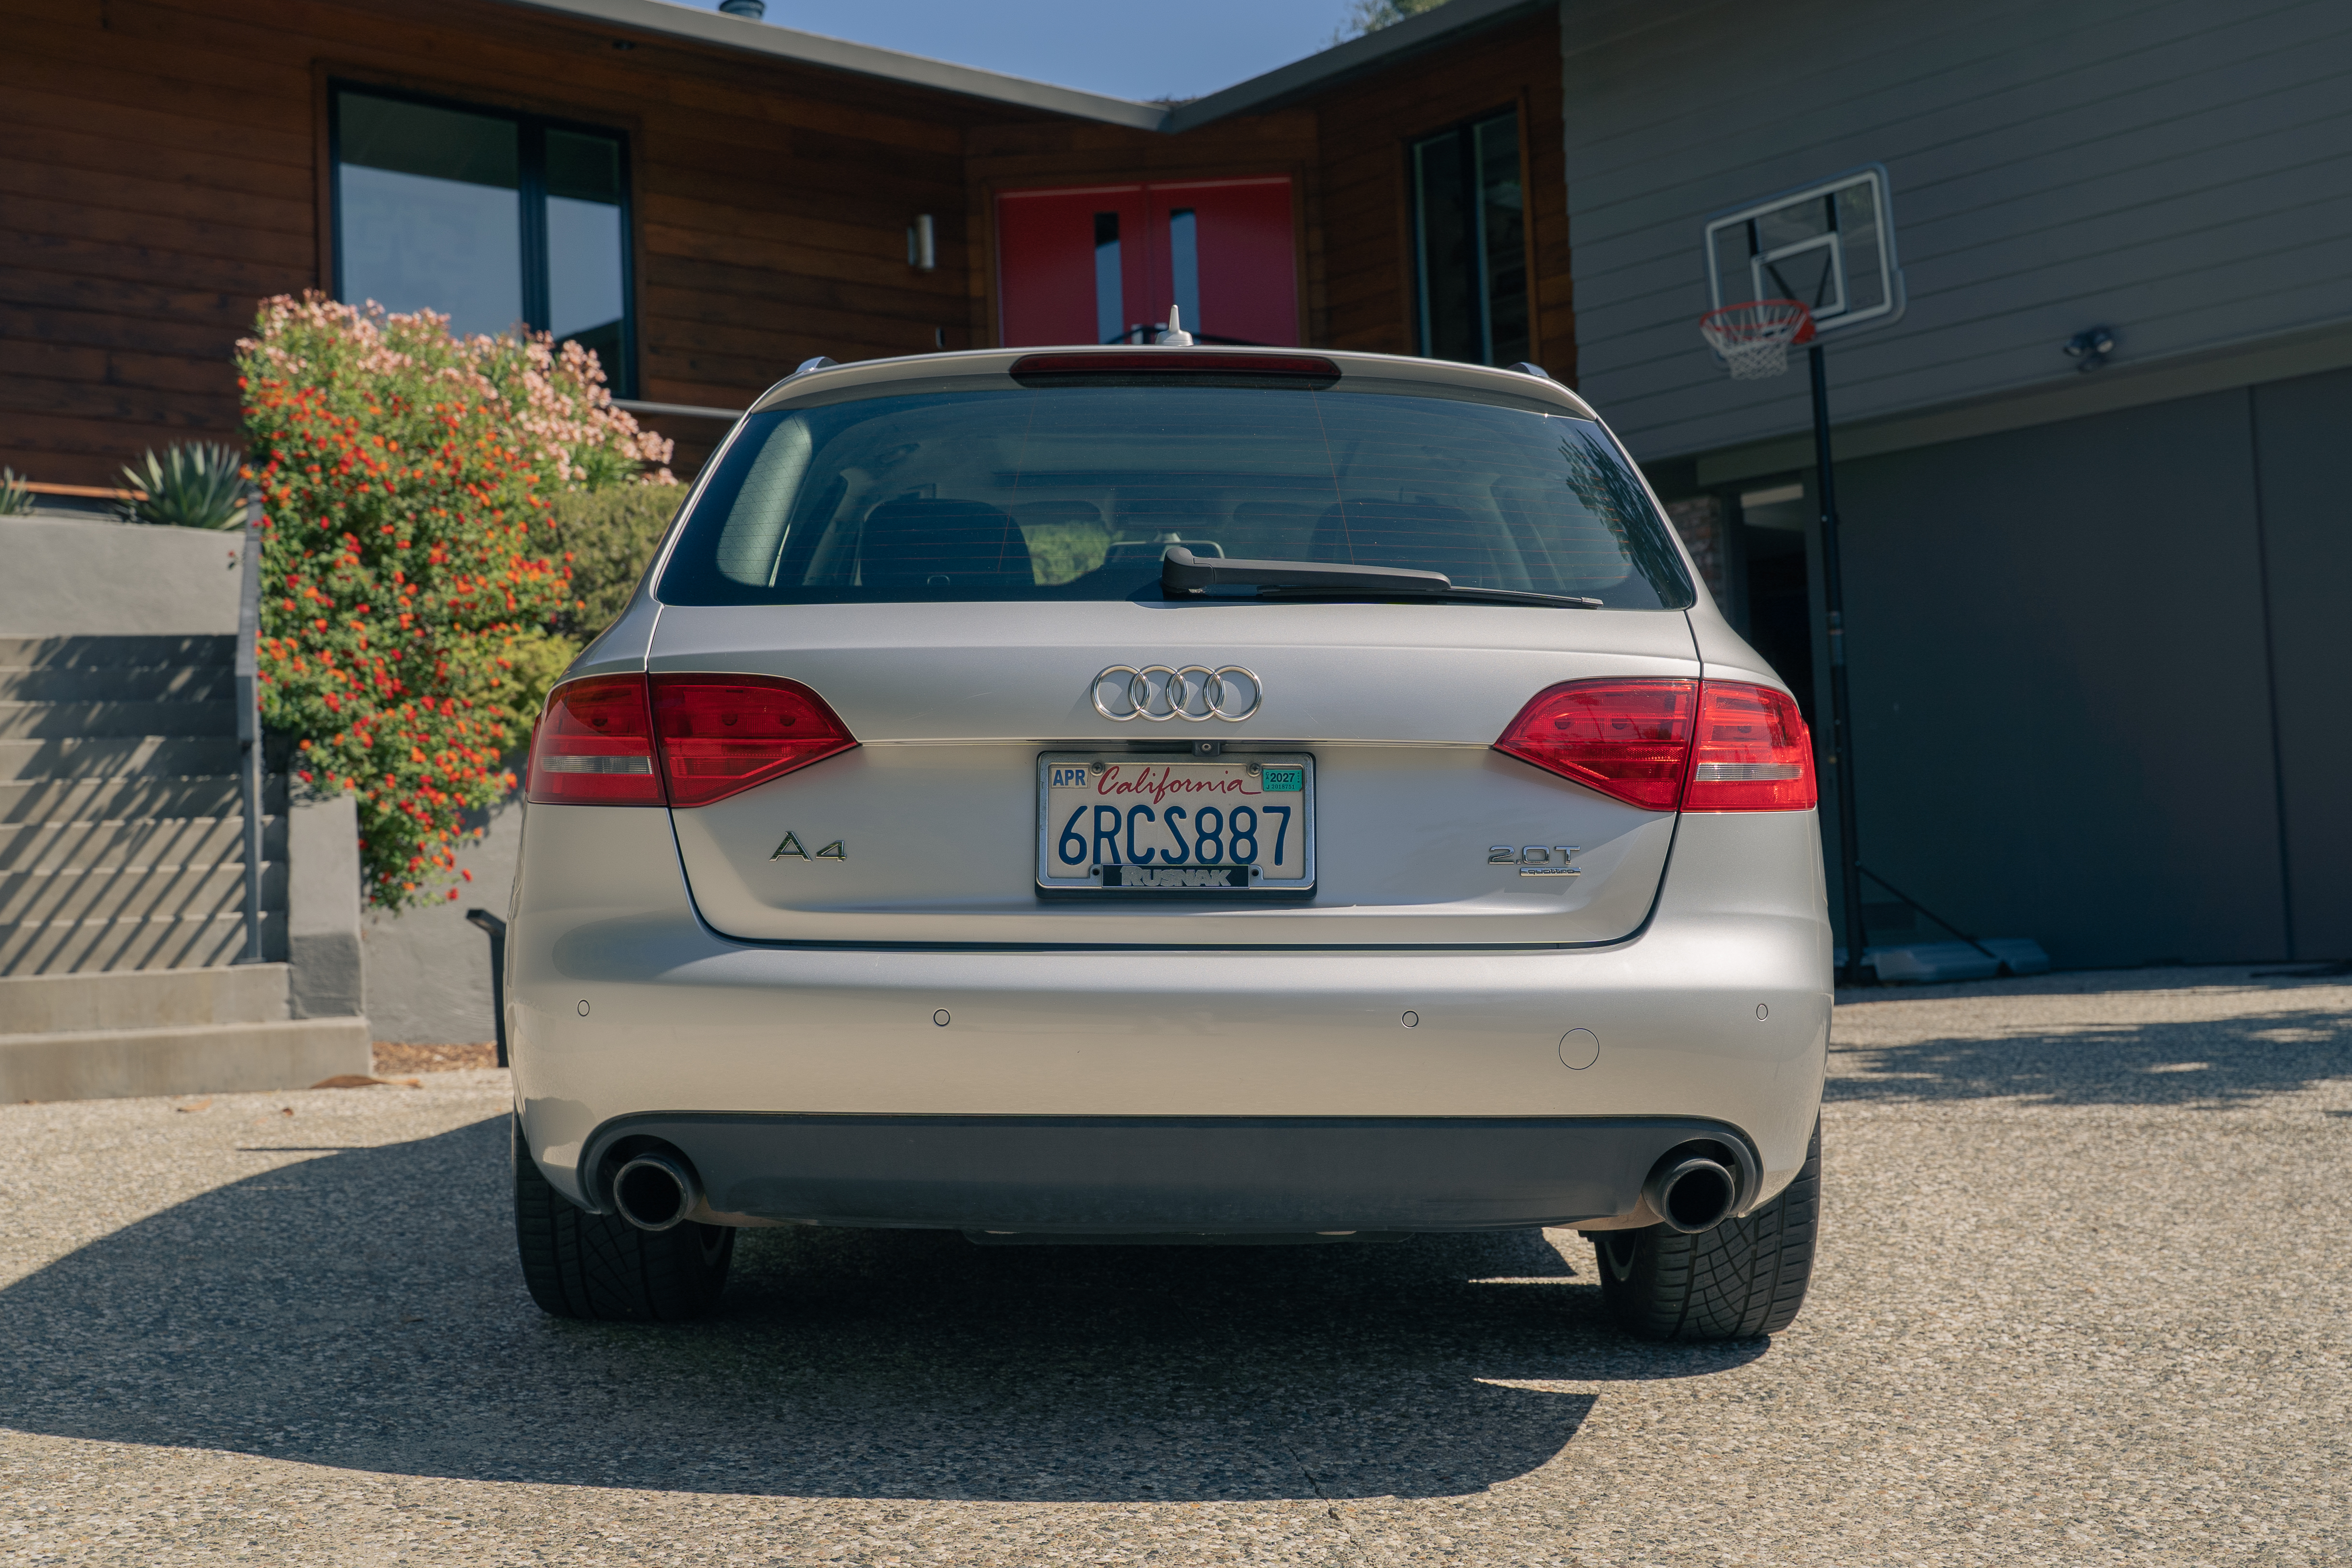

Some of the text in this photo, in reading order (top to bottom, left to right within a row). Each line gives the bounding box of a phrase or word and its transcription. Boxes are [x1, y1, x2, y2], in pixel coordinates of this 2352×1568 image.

[1053, 769, 1086, 786] APR
[1097, 765, 1262, 805] California
[1270, 772, 1295, 782] 2027
[1058, 804, 1291, 866] 6RCS887
[768, 831, 847, 863] A4
[1488, 846, 1581, 864] 2.0T
[1120, 865, 1232, 886] RUSNAK
